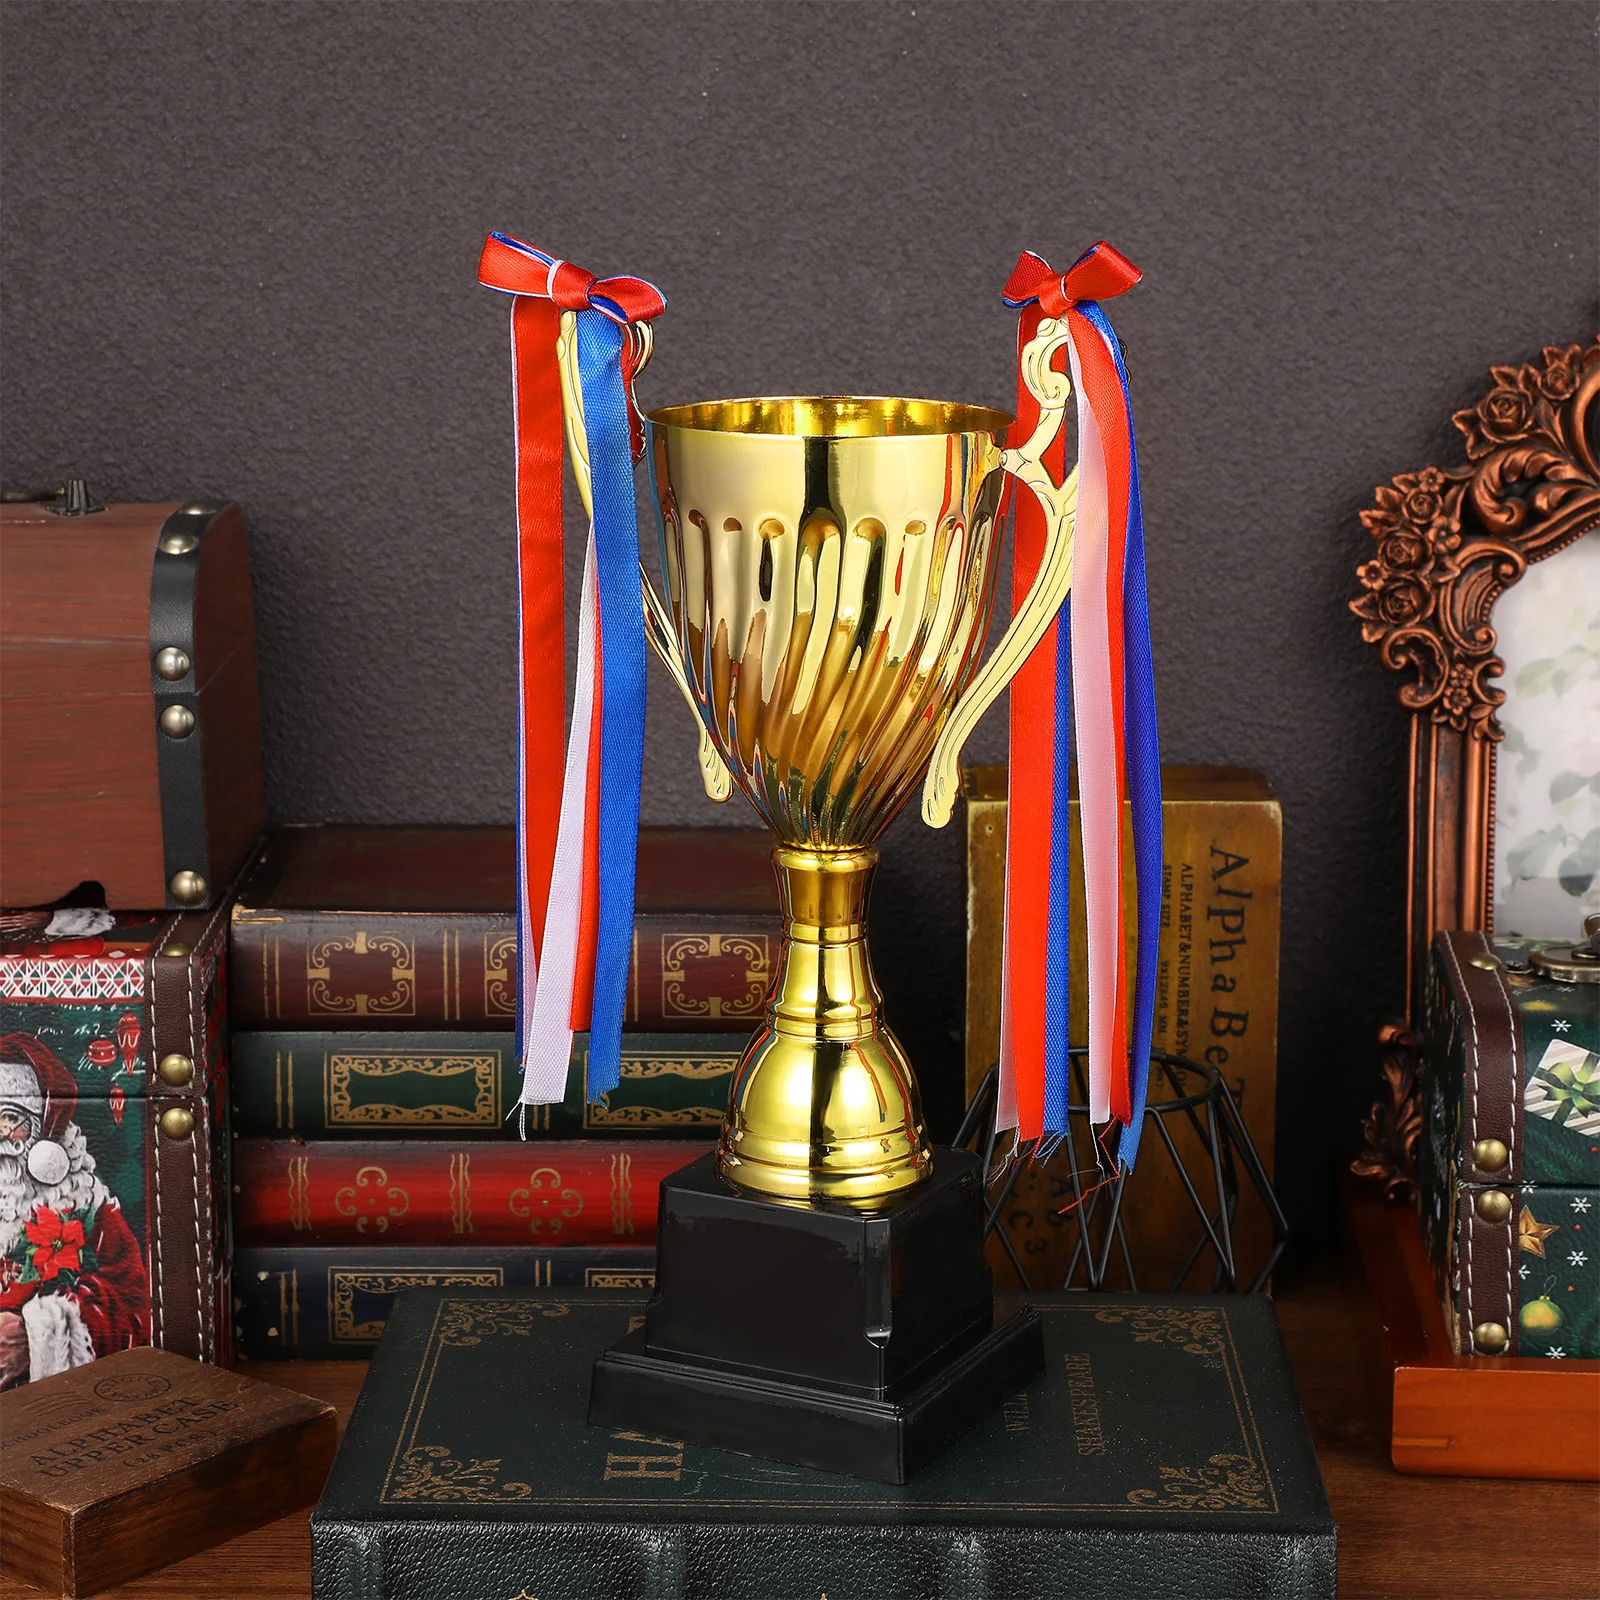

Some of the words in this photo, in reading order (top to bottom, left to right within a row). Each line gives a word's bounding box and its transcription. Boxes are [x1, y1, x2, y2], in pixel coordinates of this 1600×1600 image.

[1161, 903, 1171, 928] SIZE
[1163, 864, 1172, 899] STAMP
[1176, 863, 1194, 1090] ALPHABET&NUMBER&SYMOL
[31, 1396, 200, 1466] ALPHABET
[37, 1433, 157, 1478] UPPER
[152, 1400, 239, 1435] CASE
[1064, 1352, 1106, 1456] SHAKESPEARE
